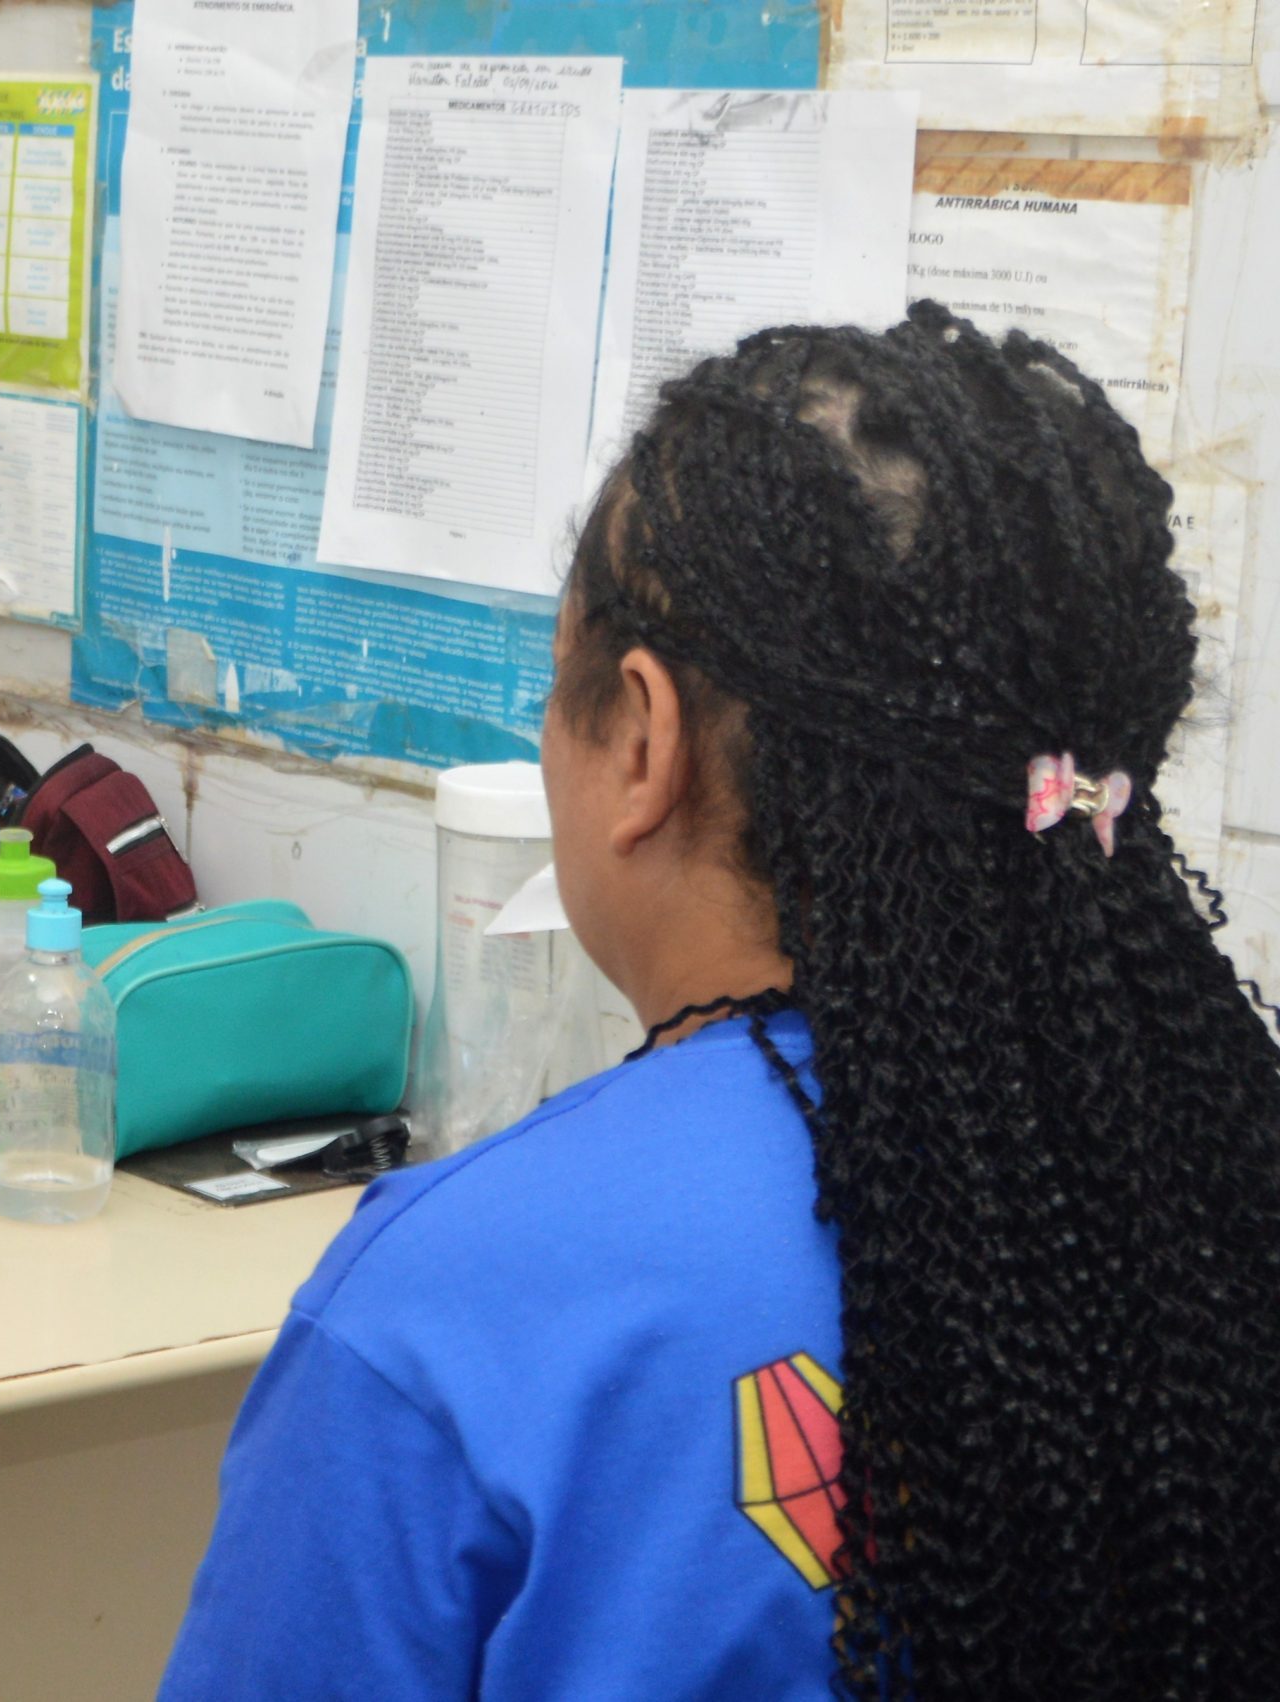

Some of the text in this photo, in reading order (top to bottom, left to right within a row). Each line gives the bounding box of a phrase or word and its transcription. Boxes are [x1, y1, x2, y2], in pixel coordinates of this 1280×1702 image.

[448, 101, 506, 112] MEDICAMENTOS
[935, 196, 1078, 215] ANTIRRÁBICA HUMANA
[953, 267, 988, 280] máxima
[989, 302, 999, 313] de
[1106, 378, 1170, 393] antirrábica)
[1187, 516, 1195, 530] E
